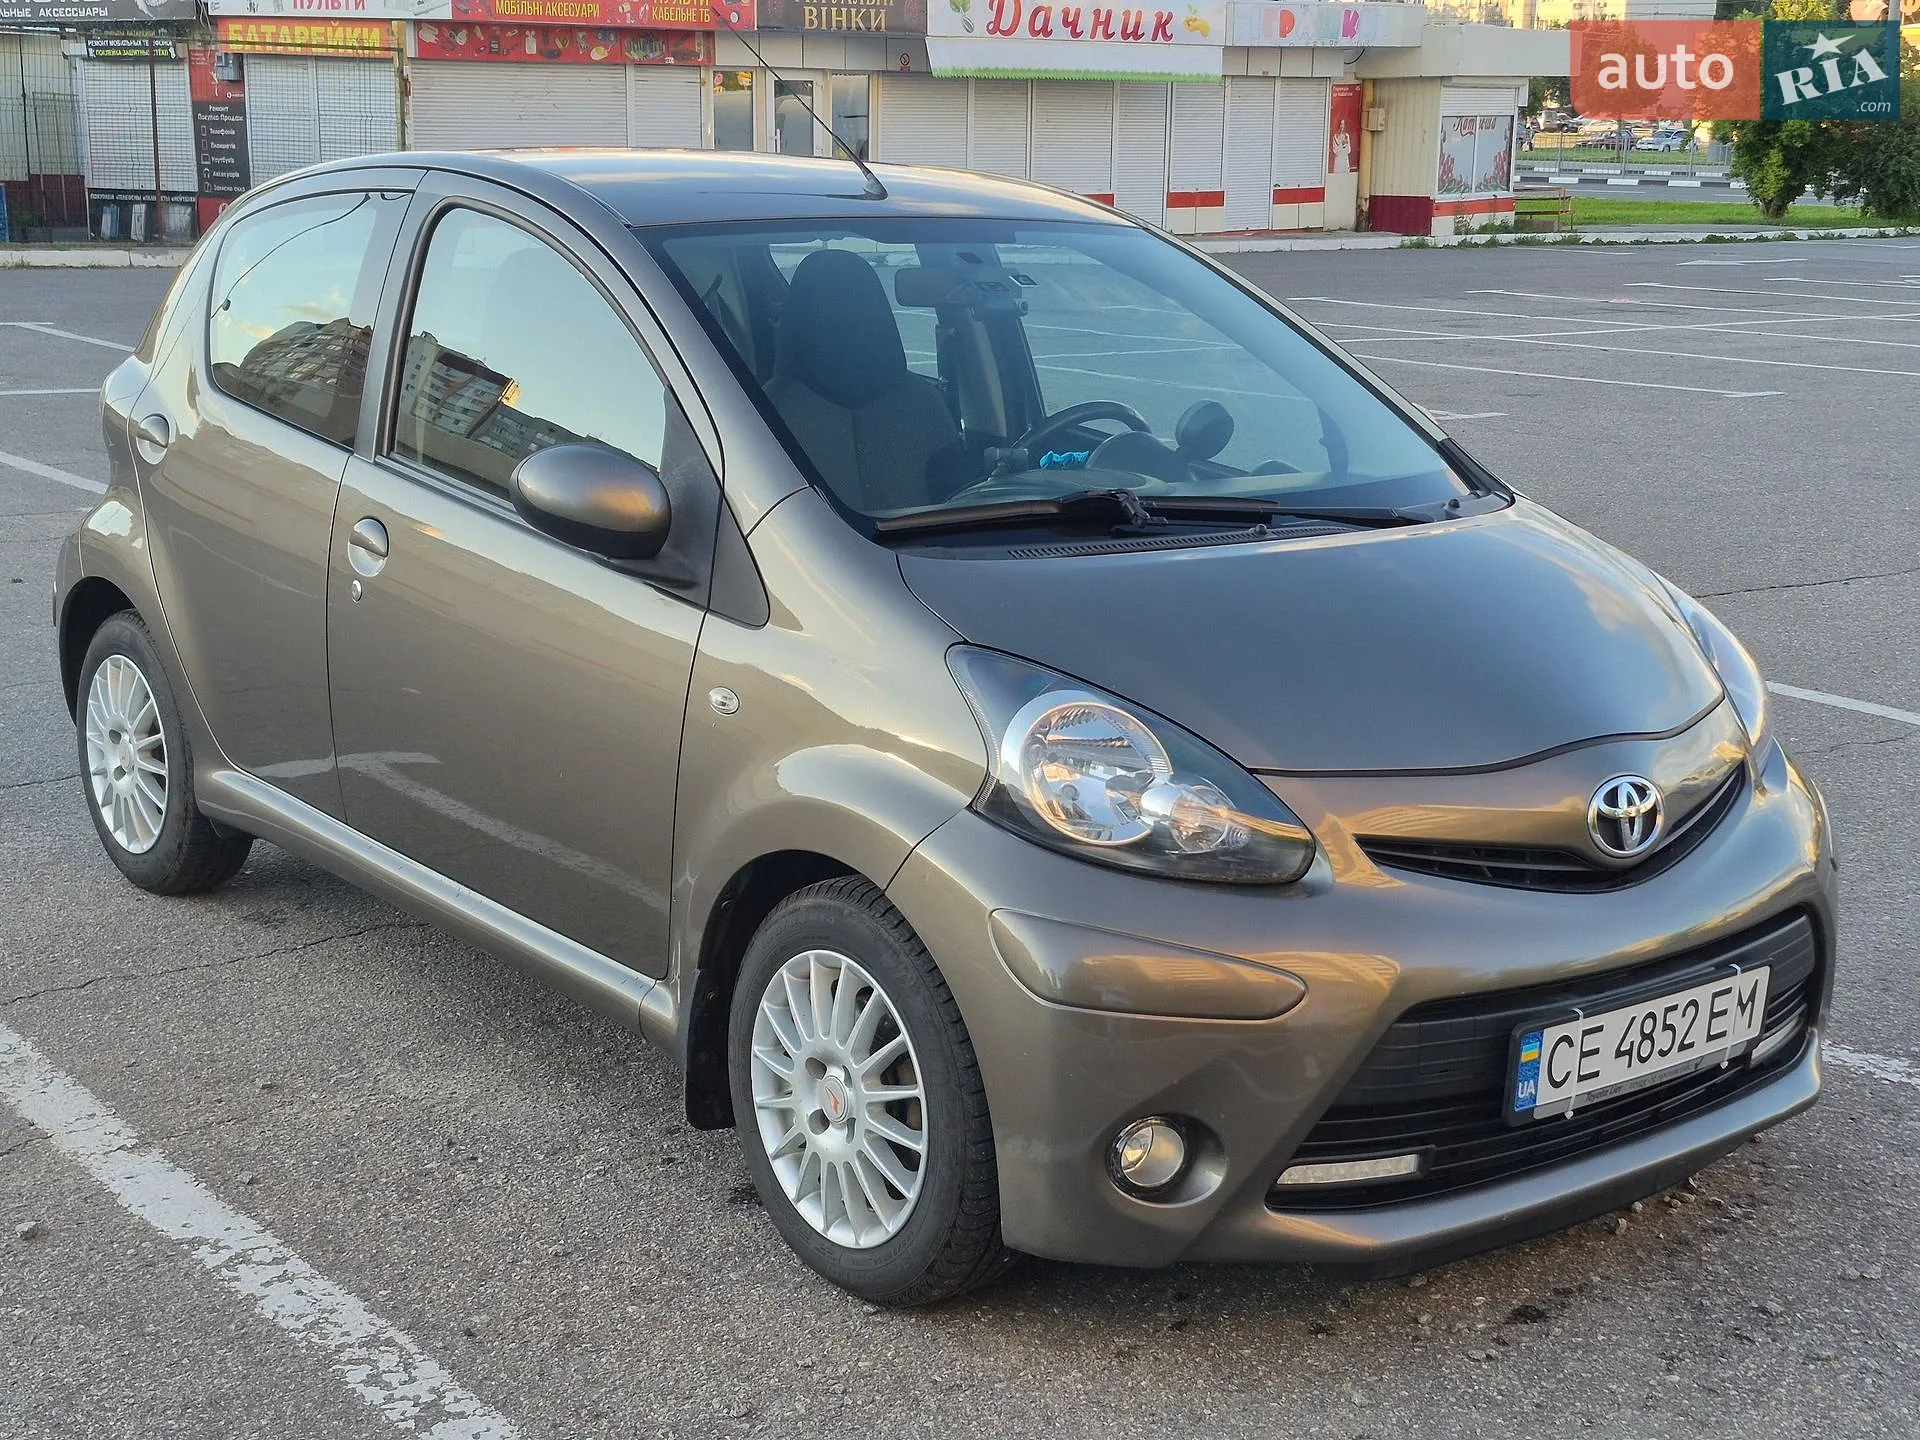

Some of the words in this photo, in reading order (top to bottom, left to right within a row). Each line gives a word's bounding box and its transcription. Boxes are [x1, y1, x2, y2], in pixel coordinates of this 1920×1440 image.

[39, 7, 108, 17] АКСЕССУАРЫ
[545, 2, 600, 17] АКСЕСУАРИ
[652, 6, 697, 22] КАБЕЛЬНЕ
[699, 8, 710, 22] ТБ
[803, 6, 887, 32] ВІНКИ
[985, 0, 1174, 42] Дачник
[227, 20, 381, 55] БАТАРЕЙКИ
[1547, 1024, 1604, 1089] CE
[1614, 998, 1700, 1069] 4852
[1705, 978, 1759, 1043] EM
[1517, 1081, 1535, 1098] UA
